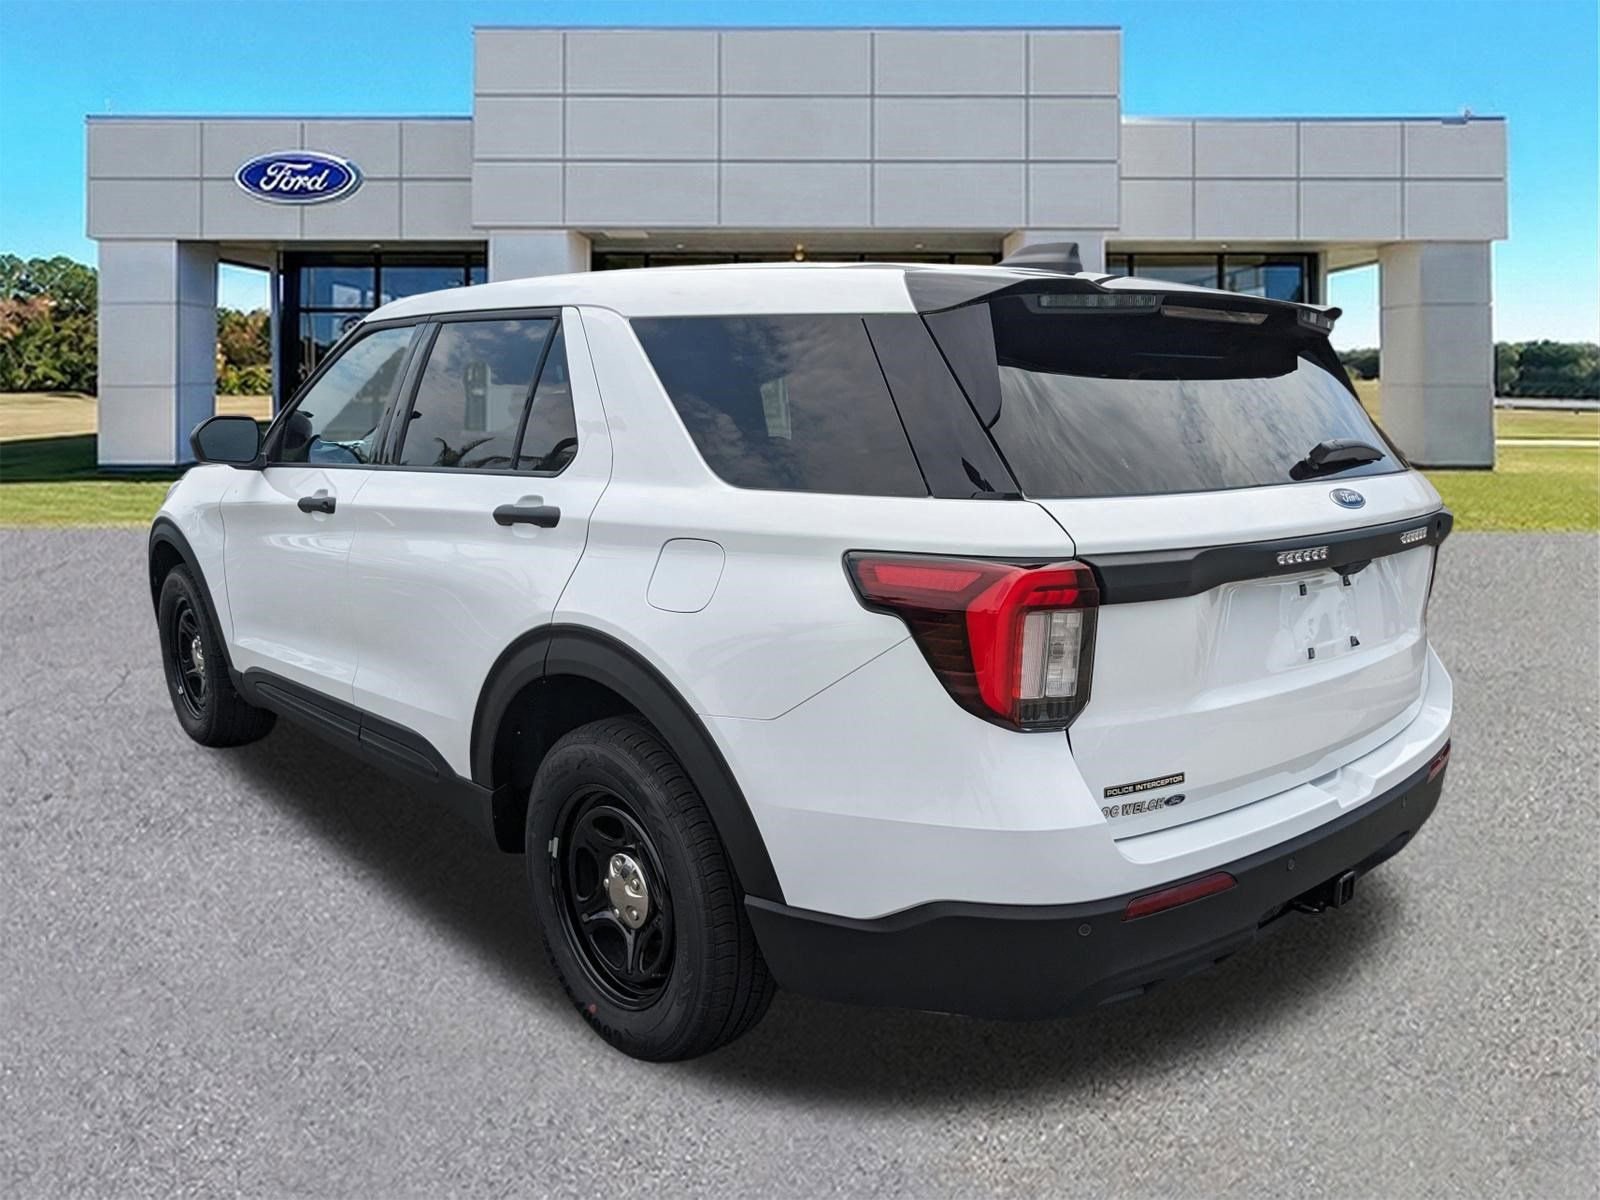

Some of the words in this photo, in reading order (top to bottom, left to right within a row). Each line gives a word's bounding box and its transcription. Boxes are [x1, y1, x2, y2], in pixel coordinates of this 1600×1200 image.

[259, 161, 330, 191] Ford
[1106, 787, 1134, 797] POLICE
[1135, 775, 1183, 790] INTERCEPTOR
[1121, 798, 1165, 815] WELCH
